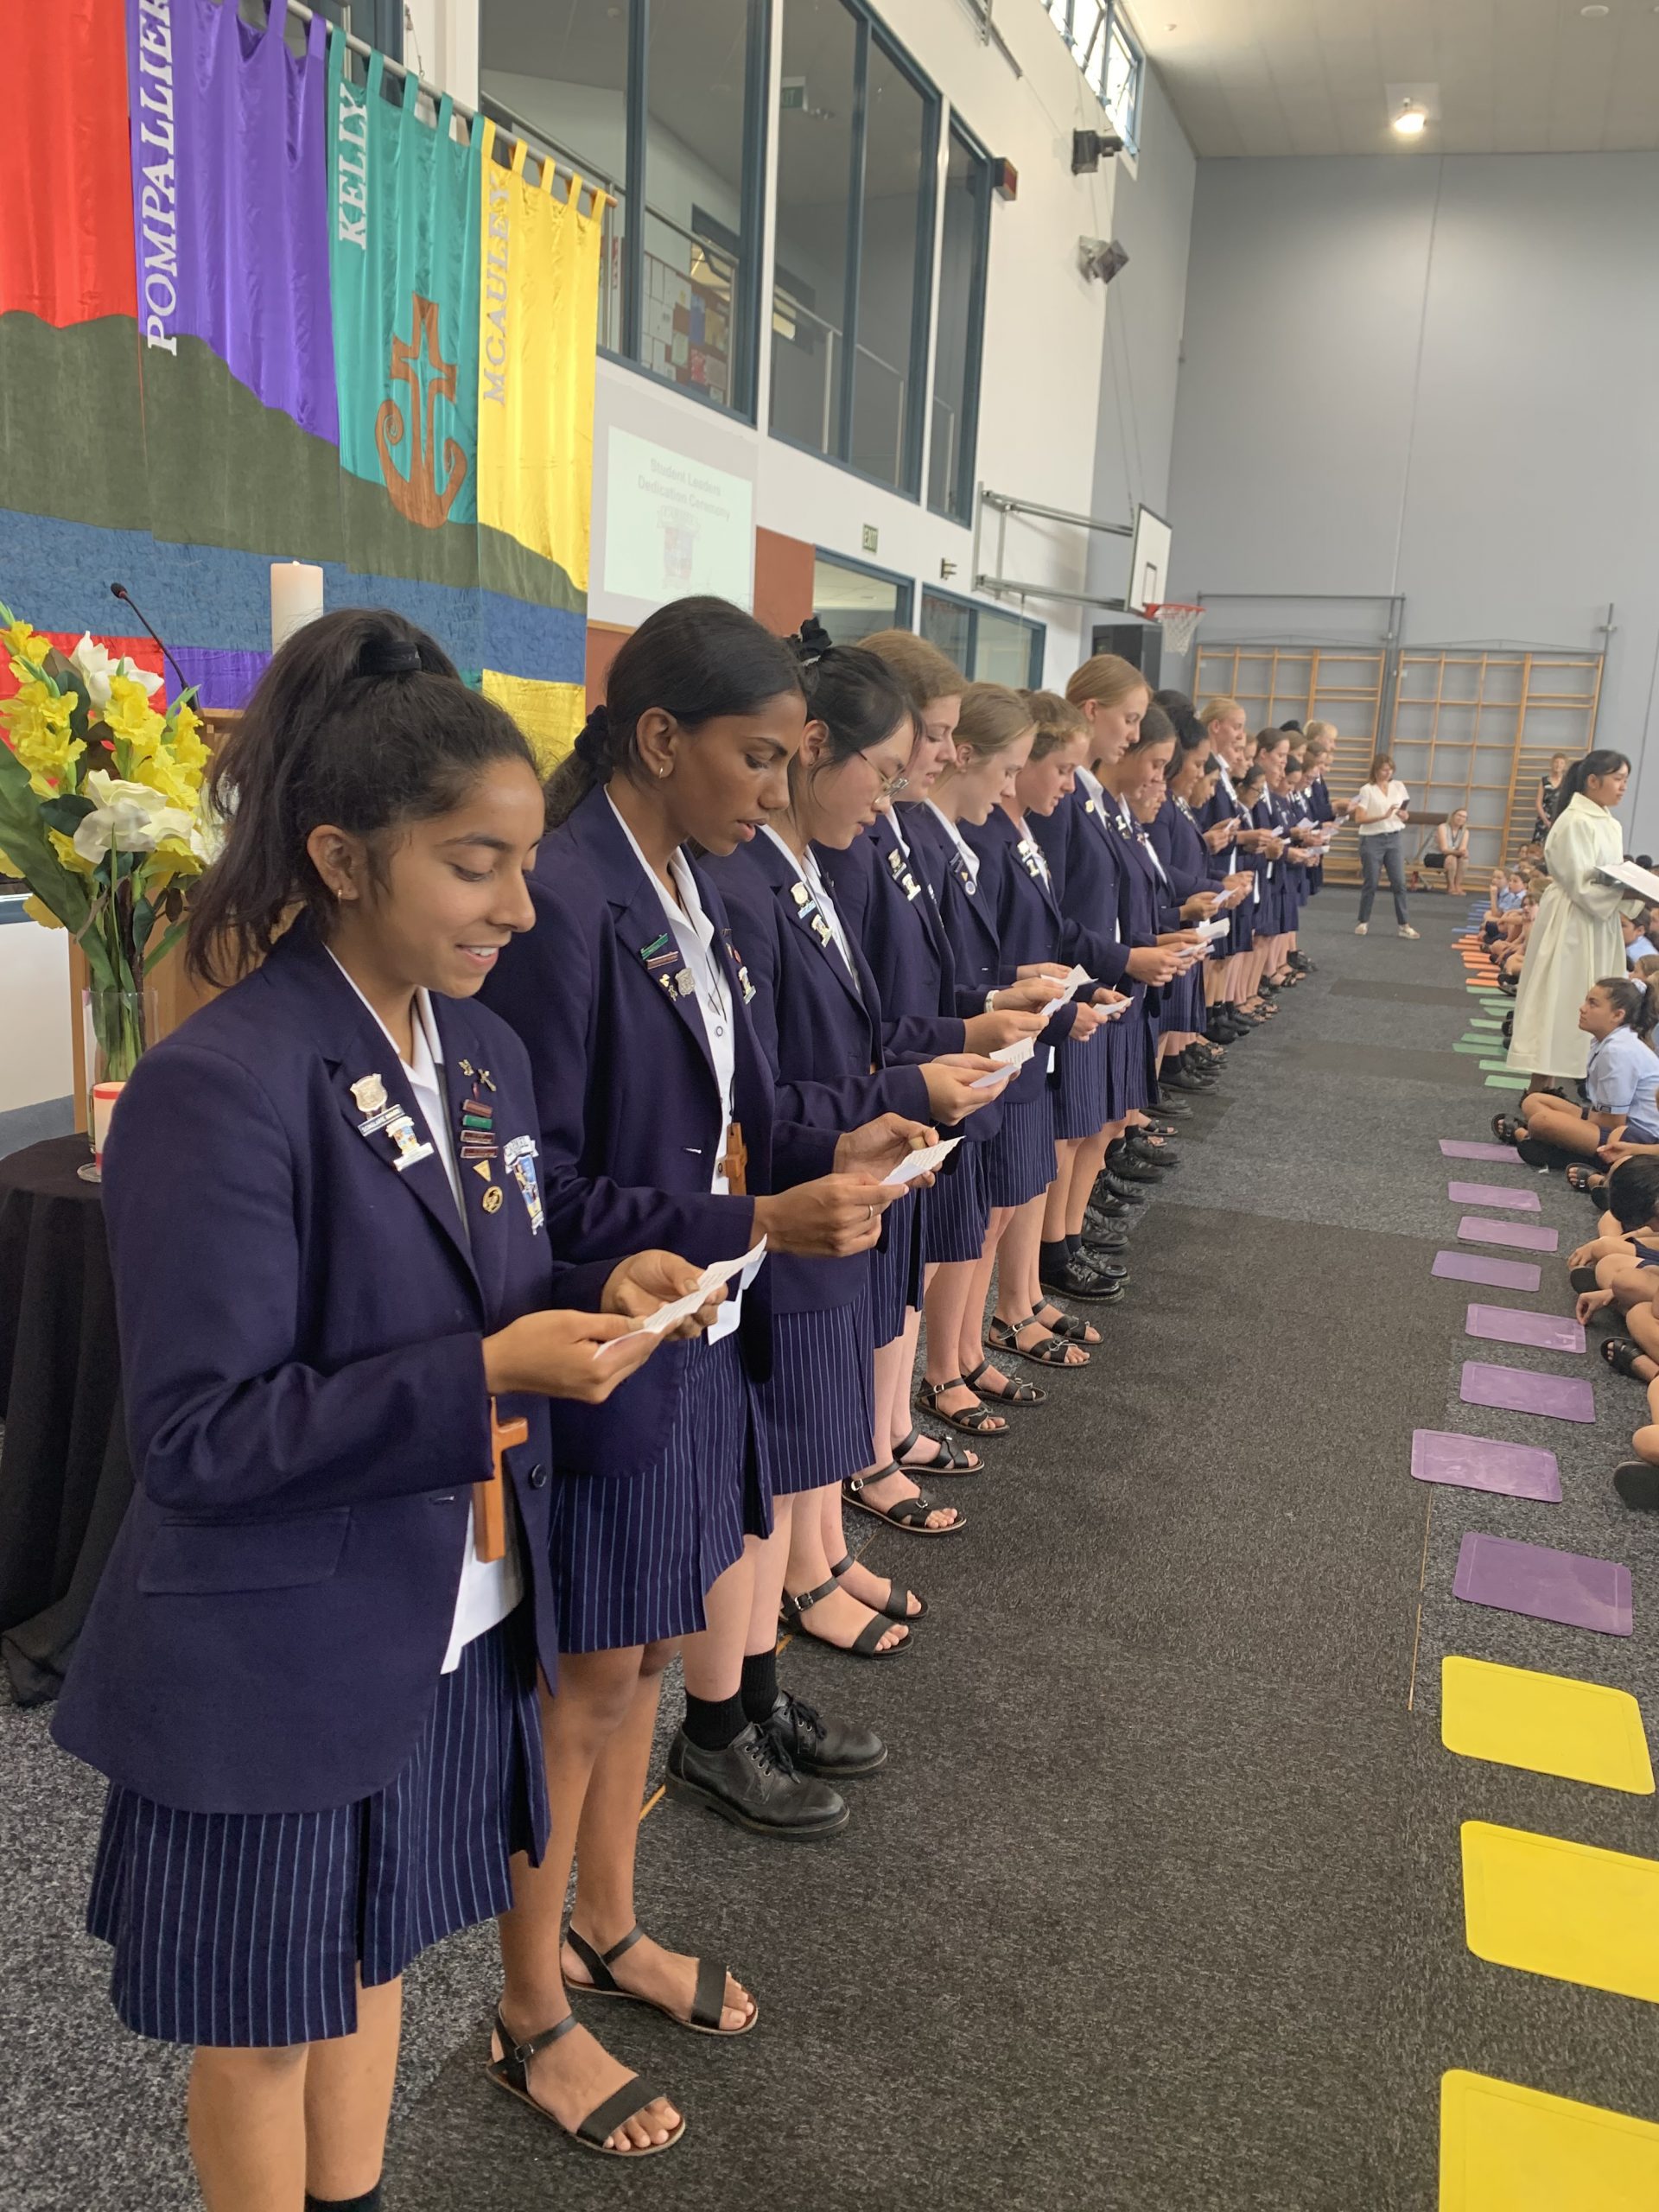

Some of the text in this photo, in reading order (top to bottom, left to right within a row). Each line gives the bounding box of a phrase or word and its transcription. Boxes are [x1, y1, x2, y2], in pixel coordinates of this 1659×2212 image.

[339, 82, 367, 250] KELLY
[483, 168, 509, 407] MCAULEY
[651, 457, 685, 483] Student
[638, 474, 687, 505] Dedication
[864, 527, 877, 549] EXIT
